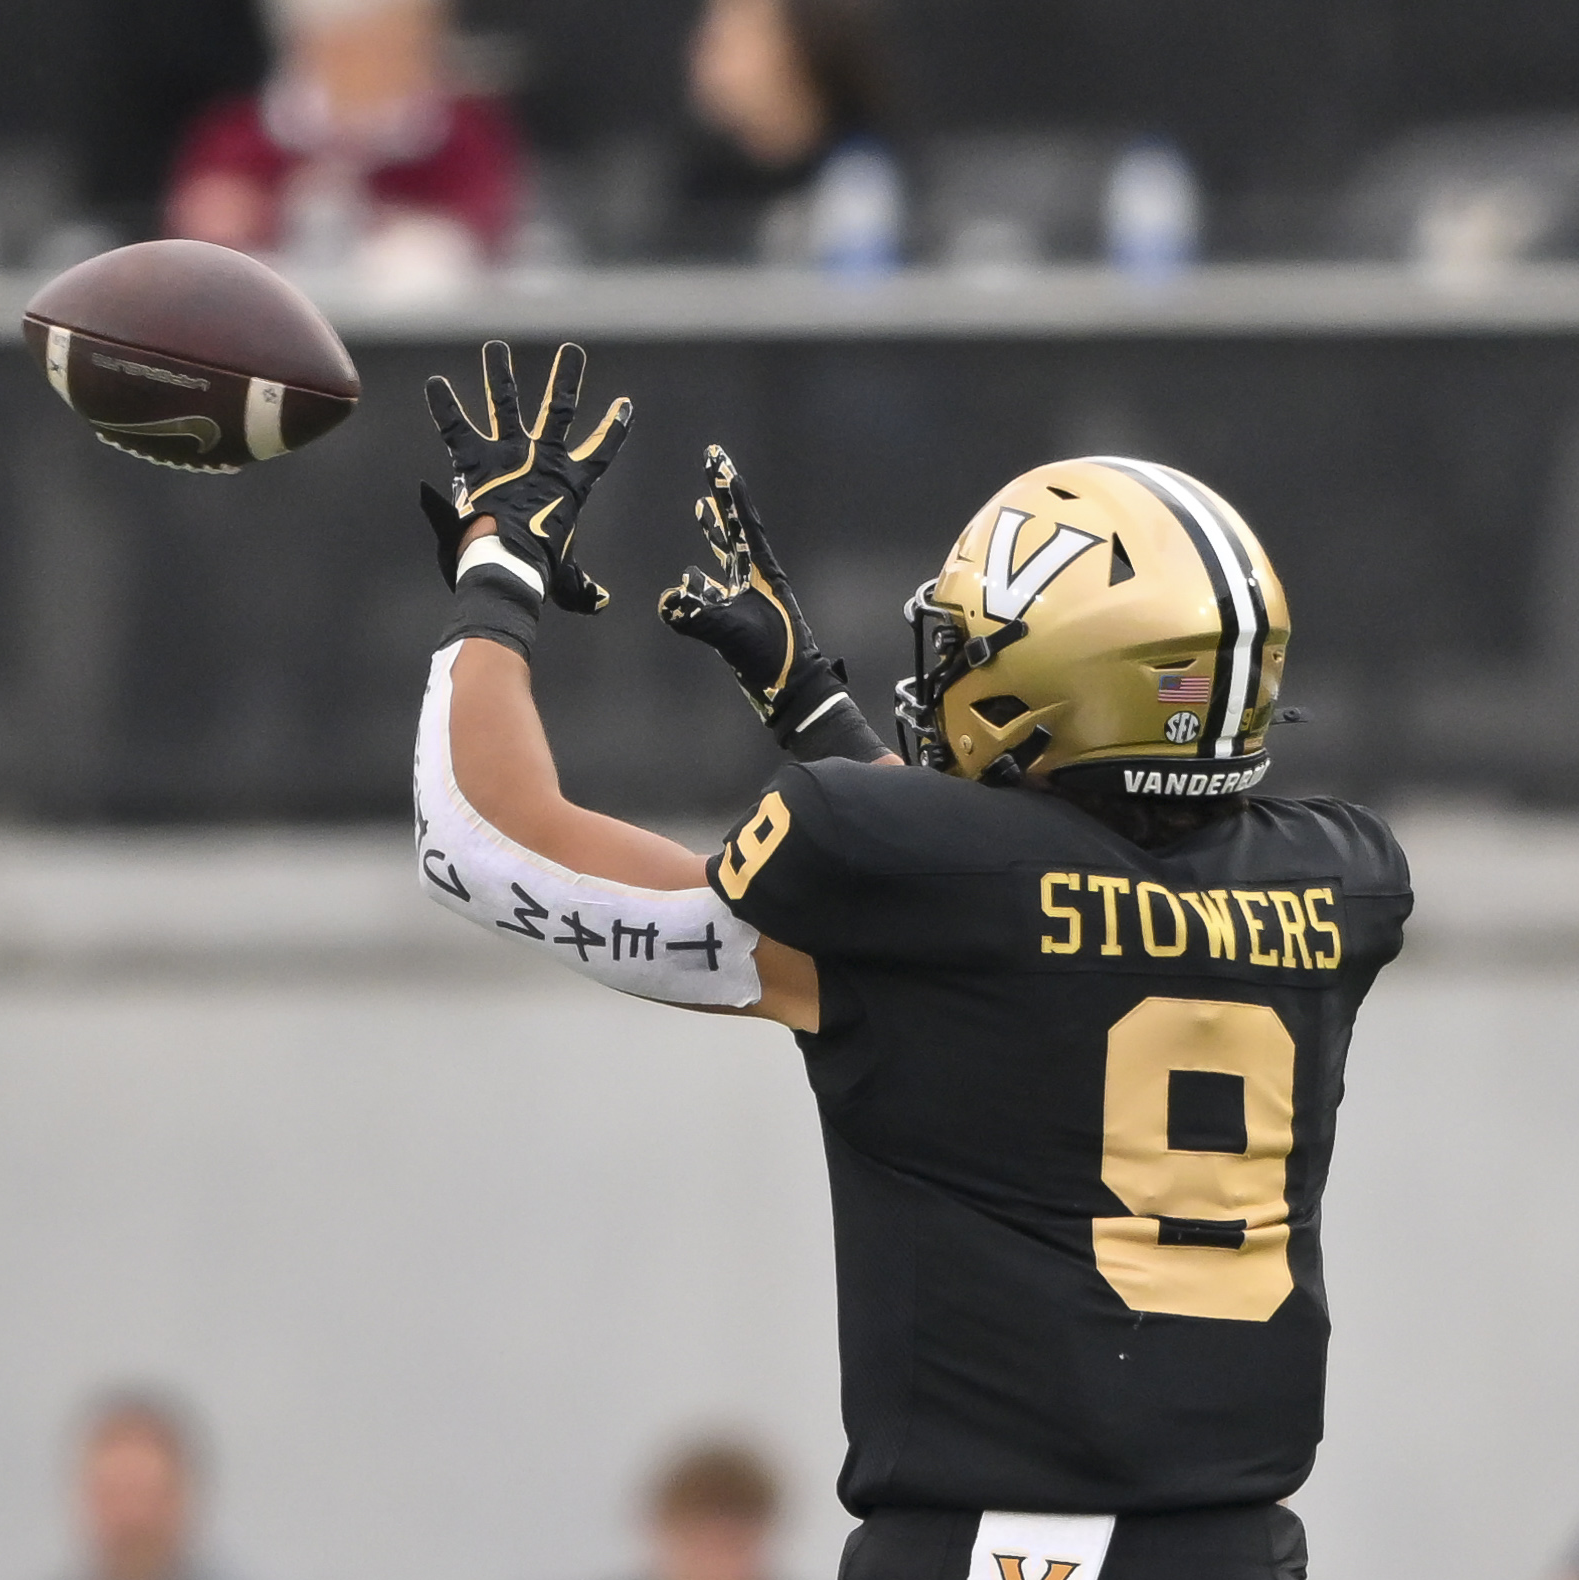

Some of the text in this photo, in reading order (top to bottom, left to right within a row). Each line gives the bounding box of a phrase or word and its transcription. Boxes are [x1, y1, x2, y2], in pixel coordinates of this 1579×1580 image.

[983, 506, 1108, 625] V
[1165, 711, 1200, 744] SEC
[1123, 757, 1271, 796] VANDERB
[718, 790, 791, 900] 9
[496, 882, 723, 971] TEAM
[1040, 872, 1343, 969] STOWERS
[1092, 996, 1296, 1322] 9
